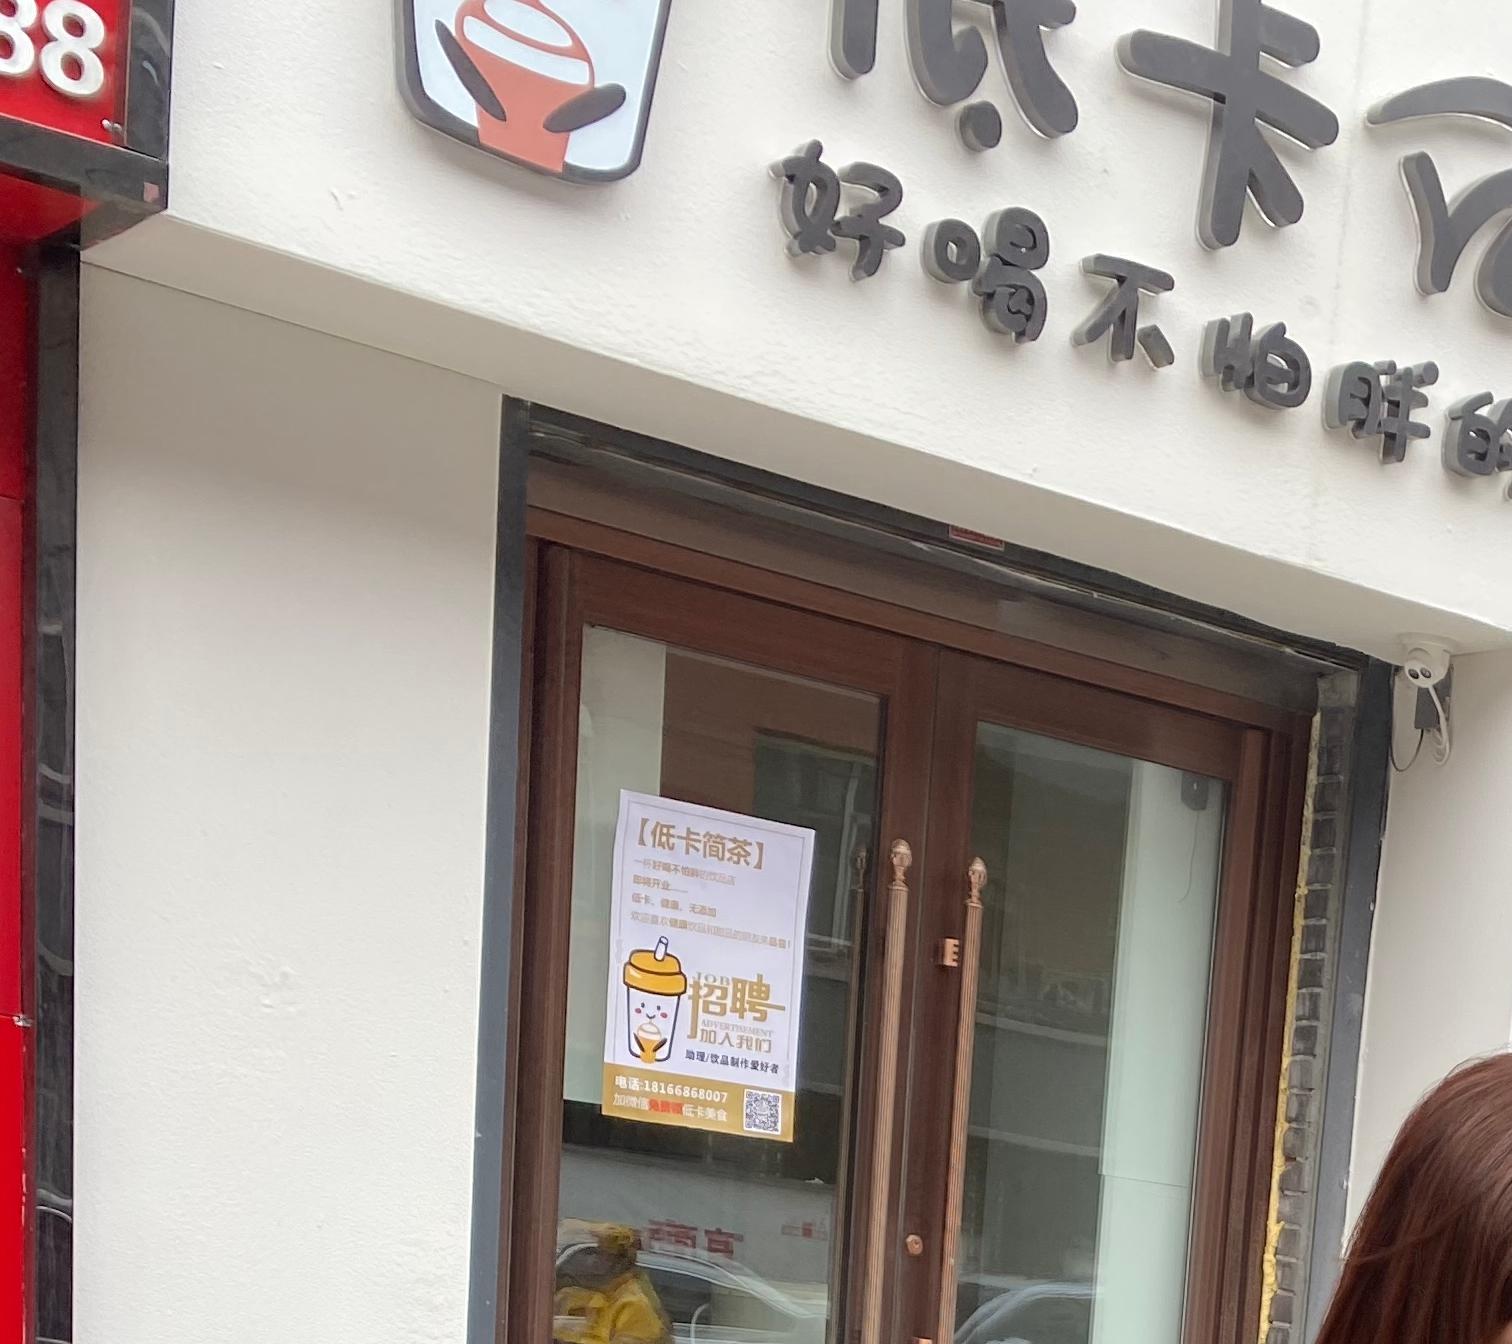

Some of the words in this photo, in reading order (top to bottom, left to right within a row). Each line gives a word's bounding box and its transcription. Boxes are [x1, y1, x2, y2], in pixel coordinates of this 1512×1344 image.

[687, 973, 786, 1040] 招聘
[699, 1028, 772, 1053] 加入我们
